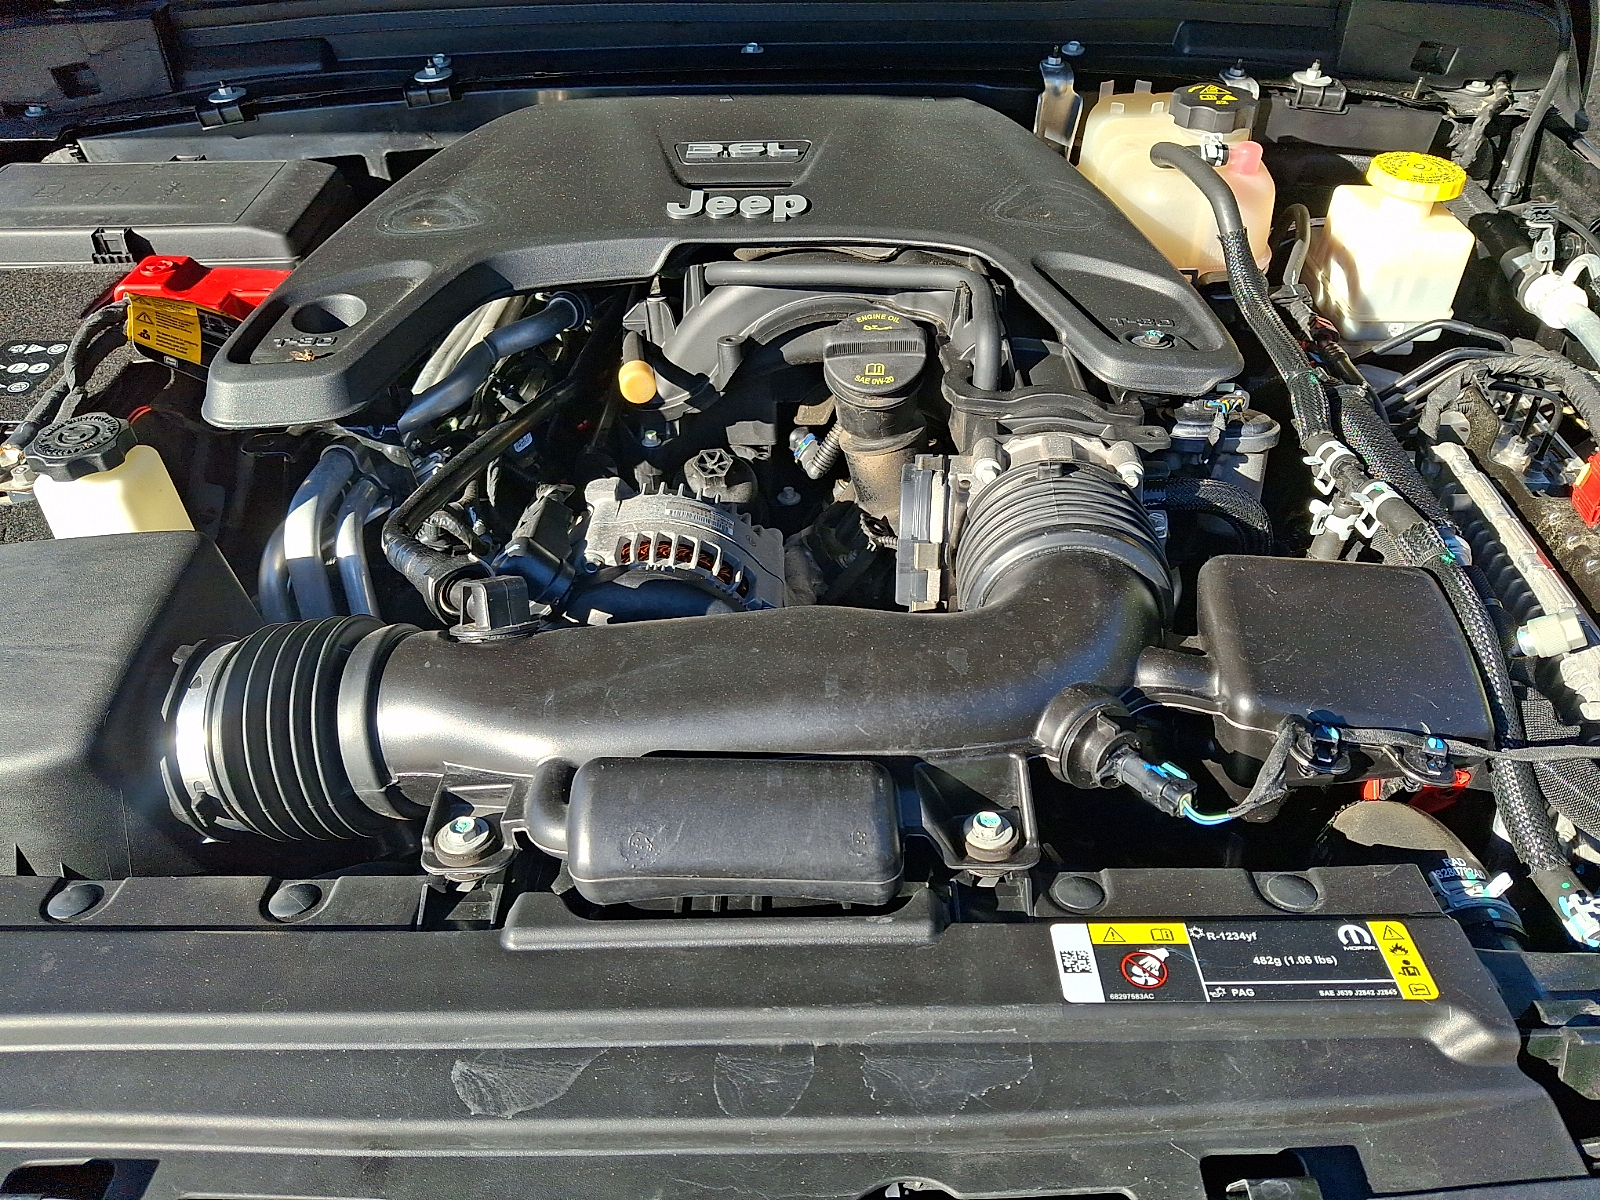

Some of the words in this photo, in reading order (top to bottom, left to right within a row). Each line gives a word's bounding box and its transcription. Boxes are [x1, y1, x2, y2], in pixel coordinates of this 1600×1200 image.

[666, 190, 808, 222] Jeep
[856, 313, 886, 323] ENGINE
[887, 315, 900, 324] OIL
[854, 374, 870, 385] SAE
[871, 375, 895, 385] 0W-20
[1441, 857, 1467, 867] RAD
[1206, 931, 1257, 942] R-1234yf
[1252, 955, 1282, 967] 482g
[1284, 955, 1312, 967] (1.06
[1314, 955, 1338, 967] lbs)
[1231, 988, 1255, 997] PAG
[1318, 989, 1335, 997] SAE
